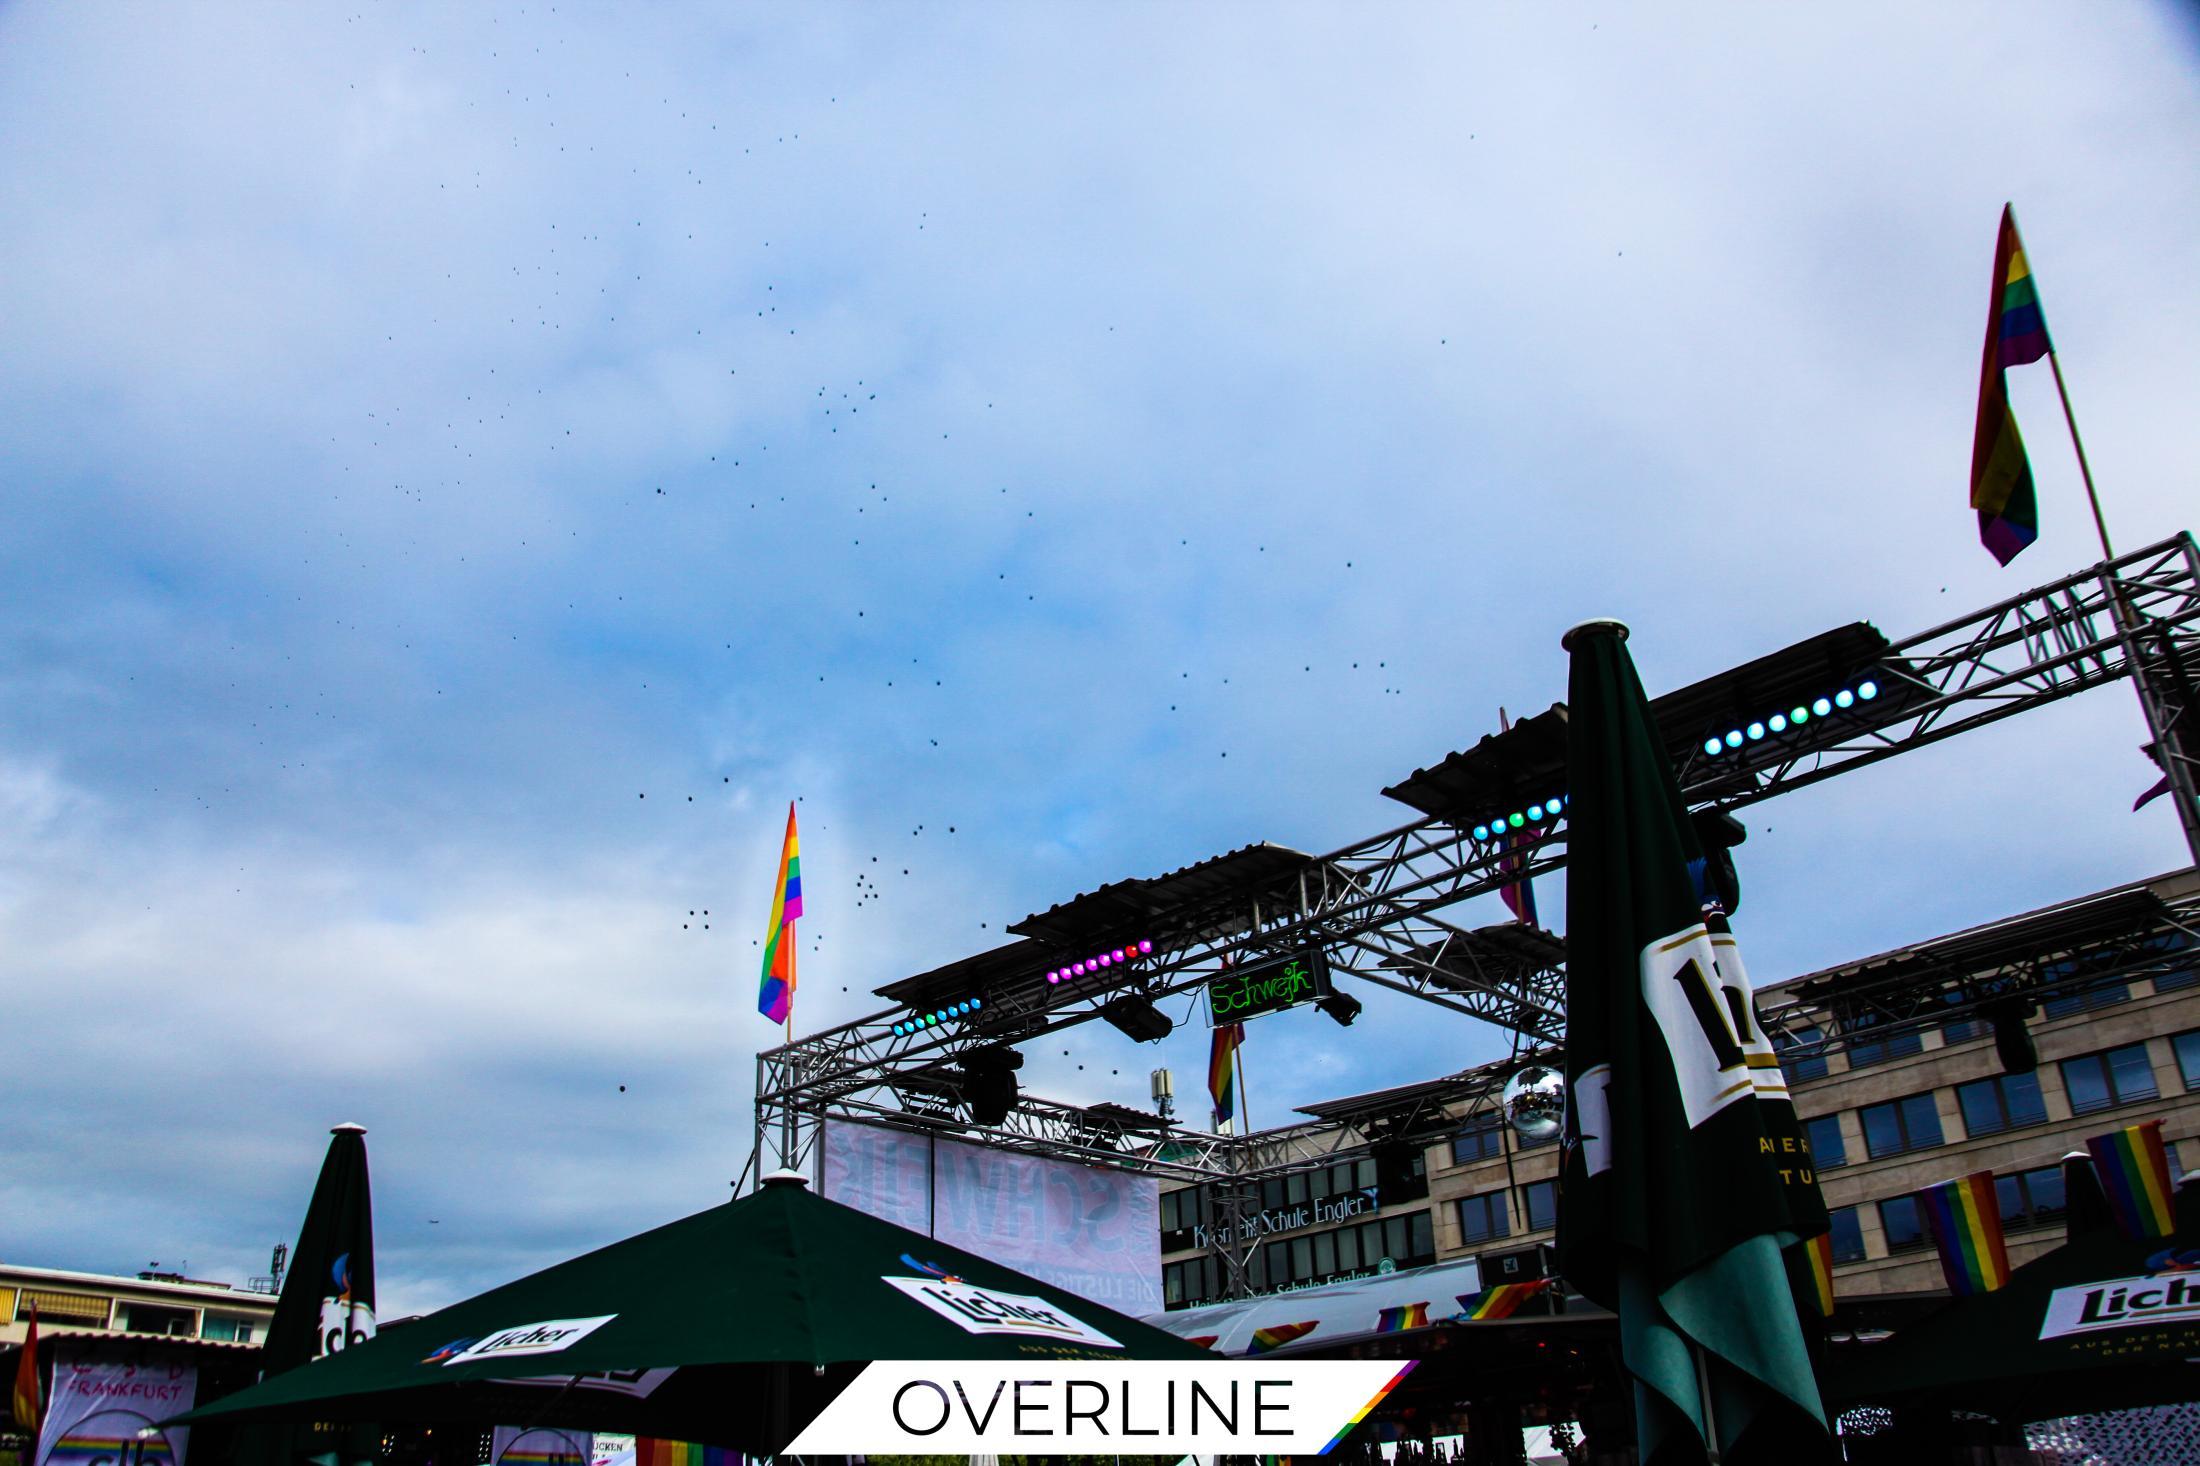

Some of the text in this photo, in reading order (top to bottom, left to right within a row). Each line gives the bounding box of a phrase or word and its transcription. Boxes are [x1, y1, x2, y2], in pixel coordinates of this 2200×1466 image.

[1261, 1209, 1309, 1235] Schule
[1314, 1196, 1365, 1224] Engler
[920, 1286, 1071, 1328] Licher
[473, 1325, 580, 1355] Licher
